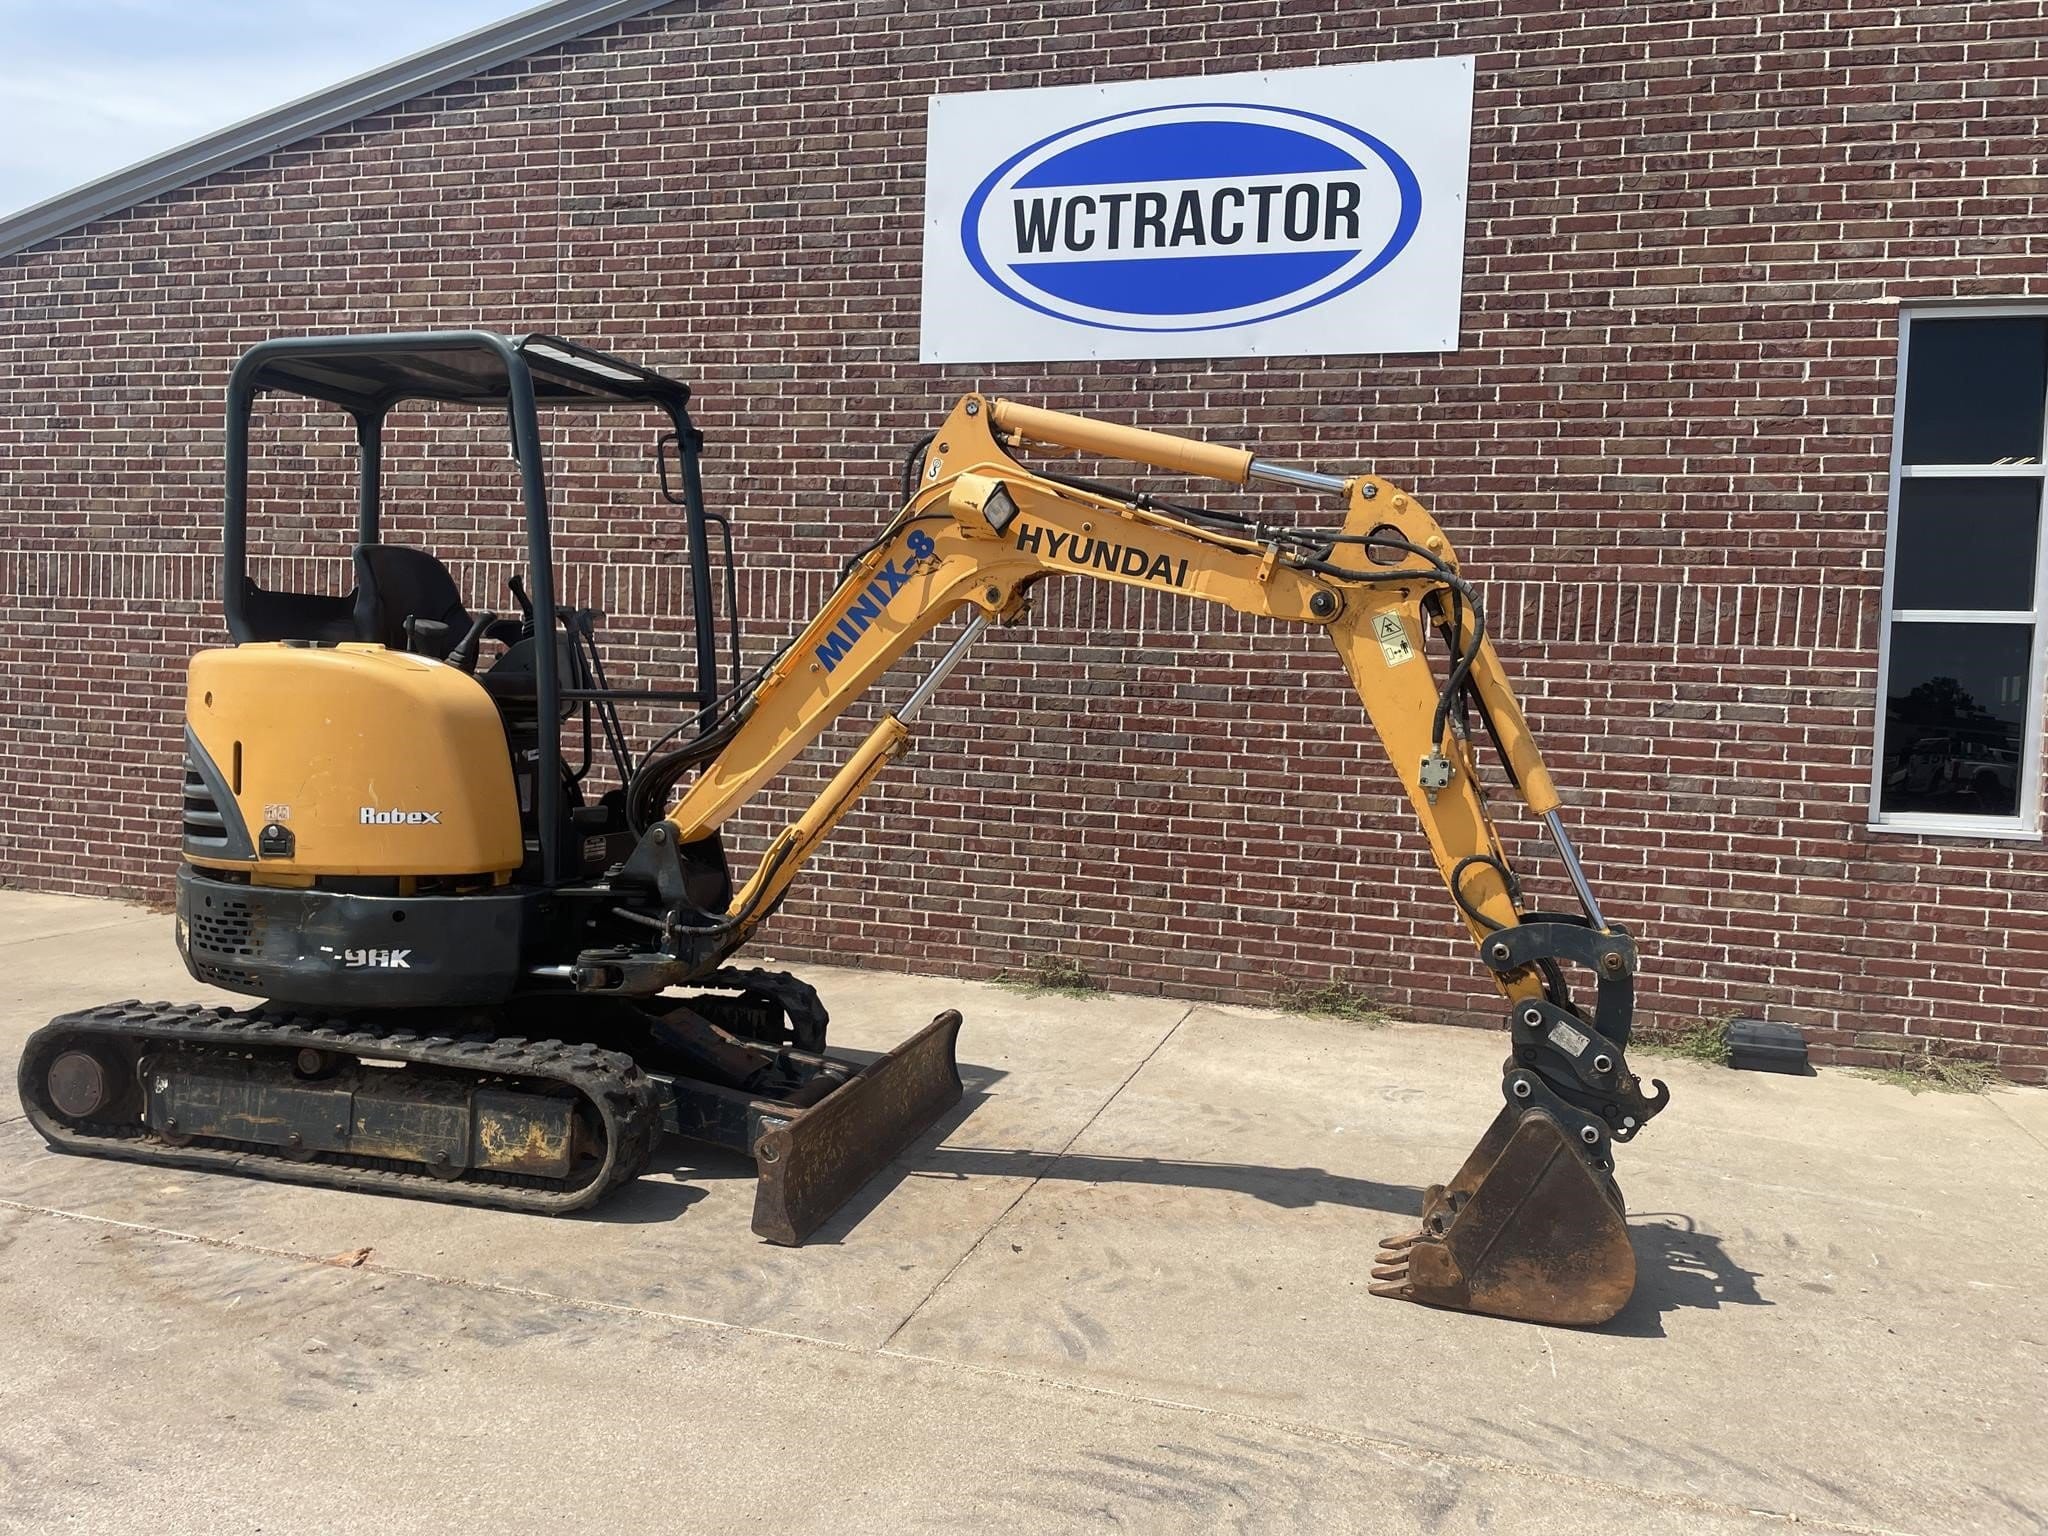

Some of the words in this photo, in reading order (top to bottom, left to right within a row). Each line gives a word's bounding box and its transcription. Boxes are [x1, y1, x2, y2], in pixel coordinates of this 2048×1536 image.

[1014, 182, 1361, 253] WCTRACTOR
[1016, 523, 1188, 587] HYUNDAI
[815, 530, 935, 673] MINIX-8
[360, 807, 441, 824] Robex
